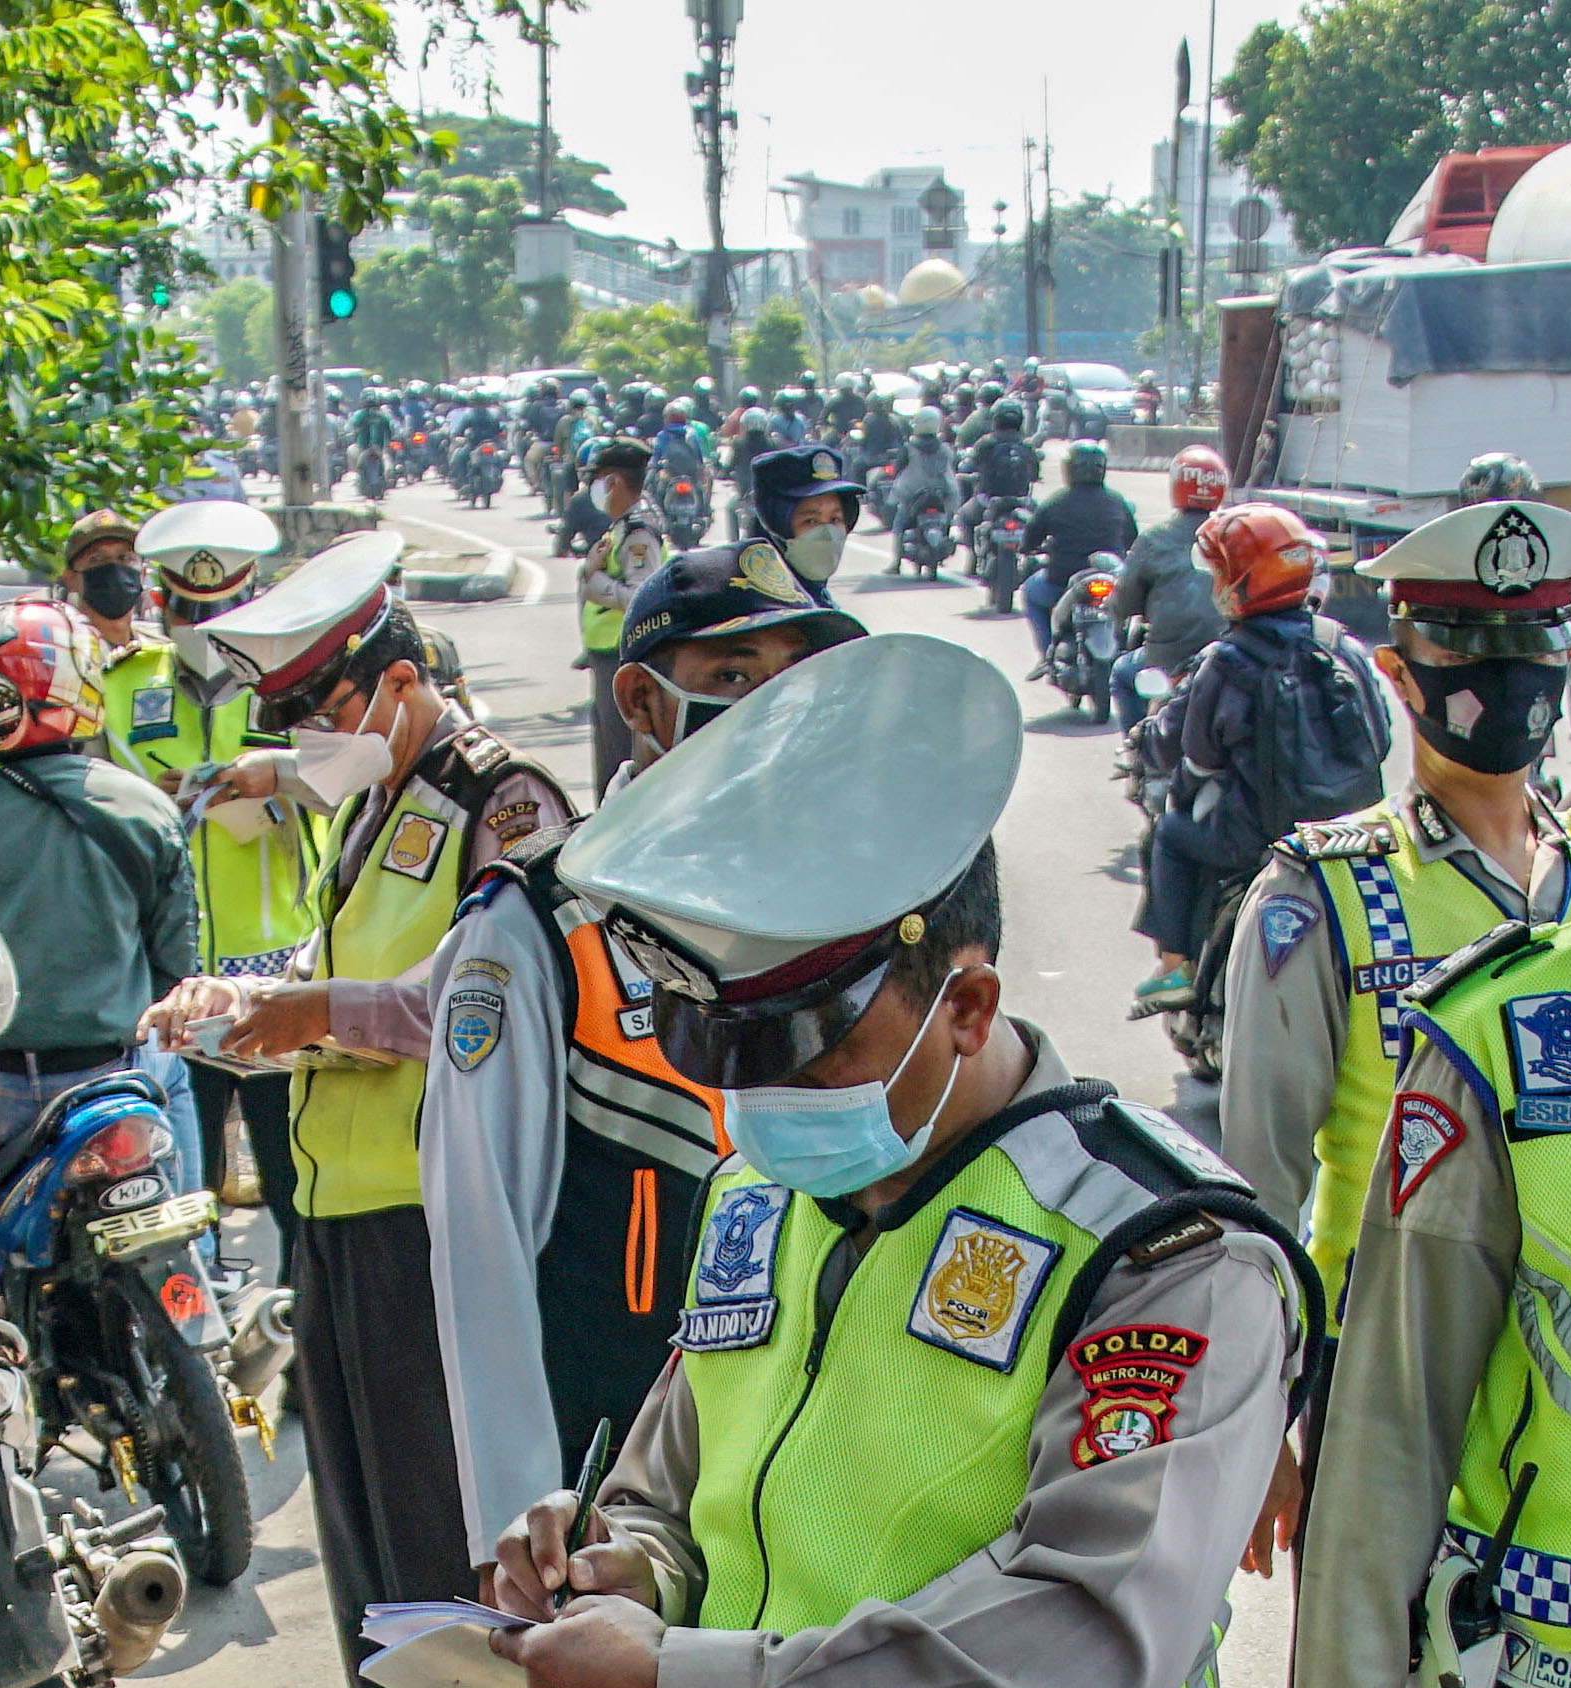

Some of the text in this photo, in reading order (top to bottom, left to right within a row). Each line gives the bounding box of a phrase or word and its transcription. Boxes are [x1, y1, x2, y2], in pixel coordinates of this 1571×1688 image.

[627, 611, 671, 648] DISHUB
[488, 802, 534, 828] POLDA
[119, 1181, 151, 1201] Kyt
[1147, 1222, 1206, 1253] POLISI
[947, 1299, 988, 1320] POLISI
[1084, 1331, 1190, 1363] POLDA
[1092, 1367, 1175, 1387] METRO-JAYA
[1536, 1670, 1565, 1688] LALU
